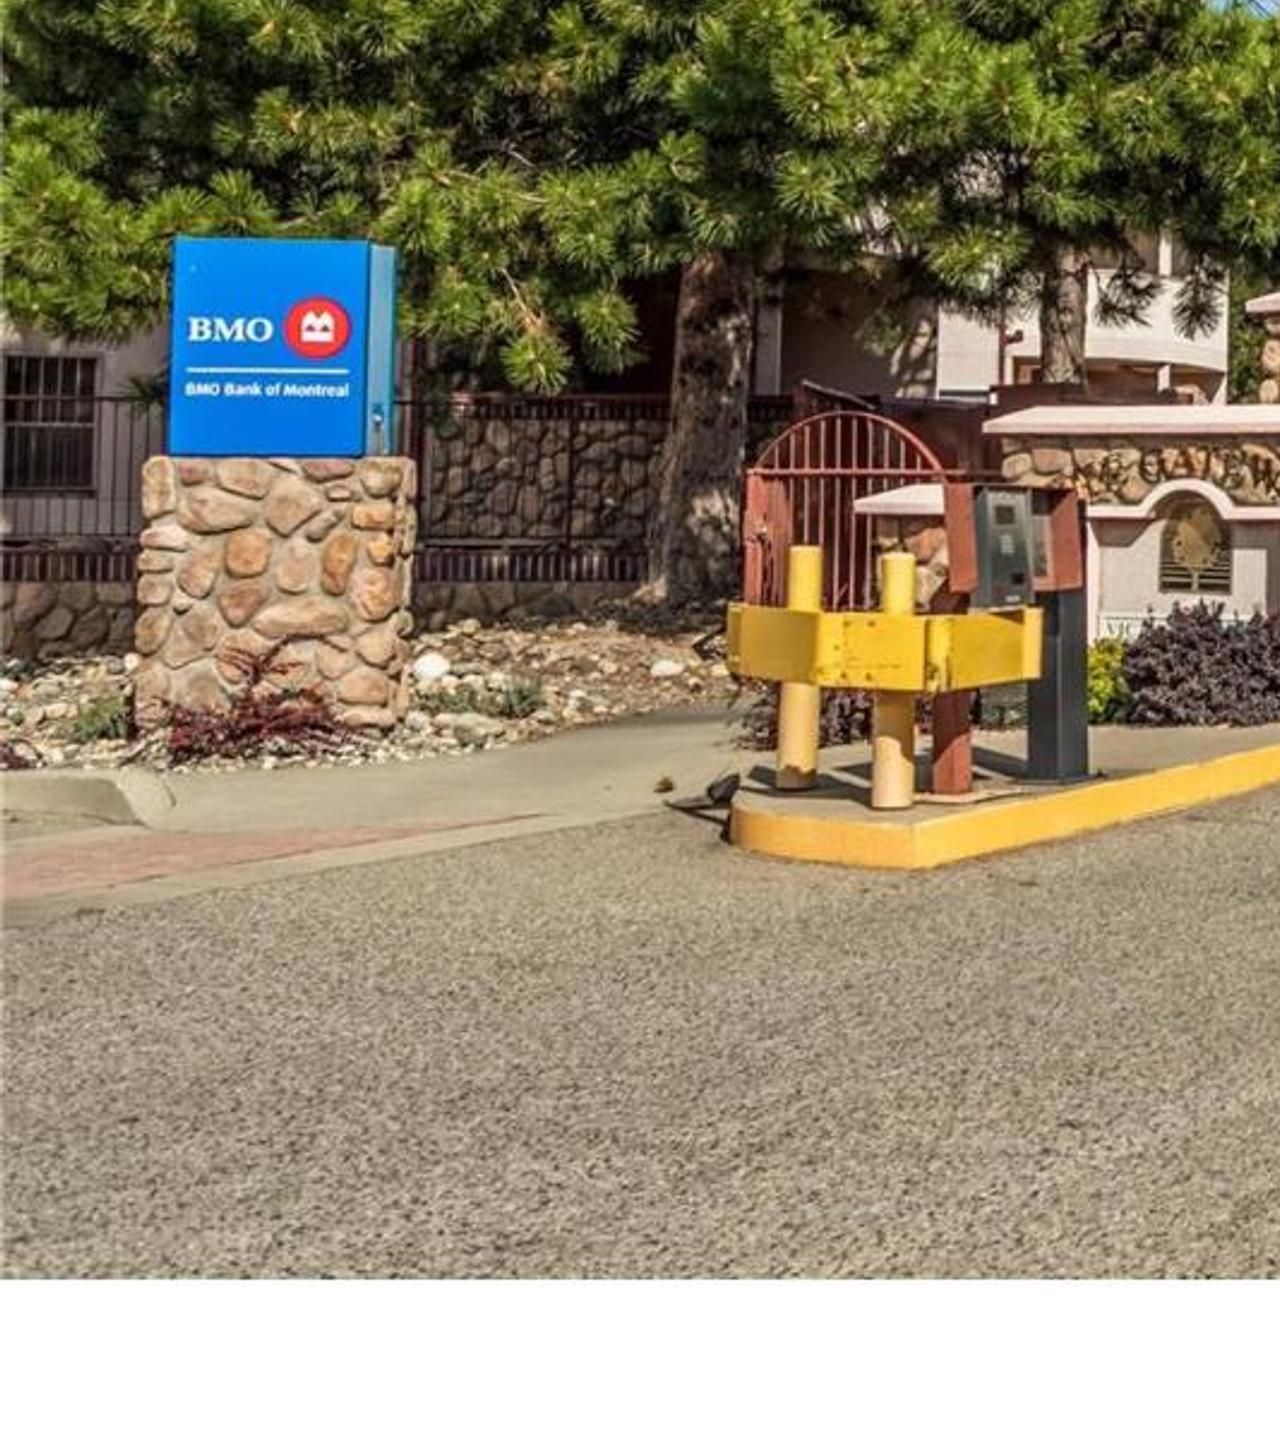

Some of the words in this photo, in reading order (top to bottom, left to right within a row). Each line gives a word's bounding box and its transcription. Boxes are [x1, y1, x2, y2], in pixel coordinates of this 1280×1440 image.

[188, 316, 274, 343] BMO
[185, 382, 220, 397] BMO
[224, 381, 262, 397] Bank
[265, 381, 281, 396] of
[283, 382, 350, 399] Montreal
